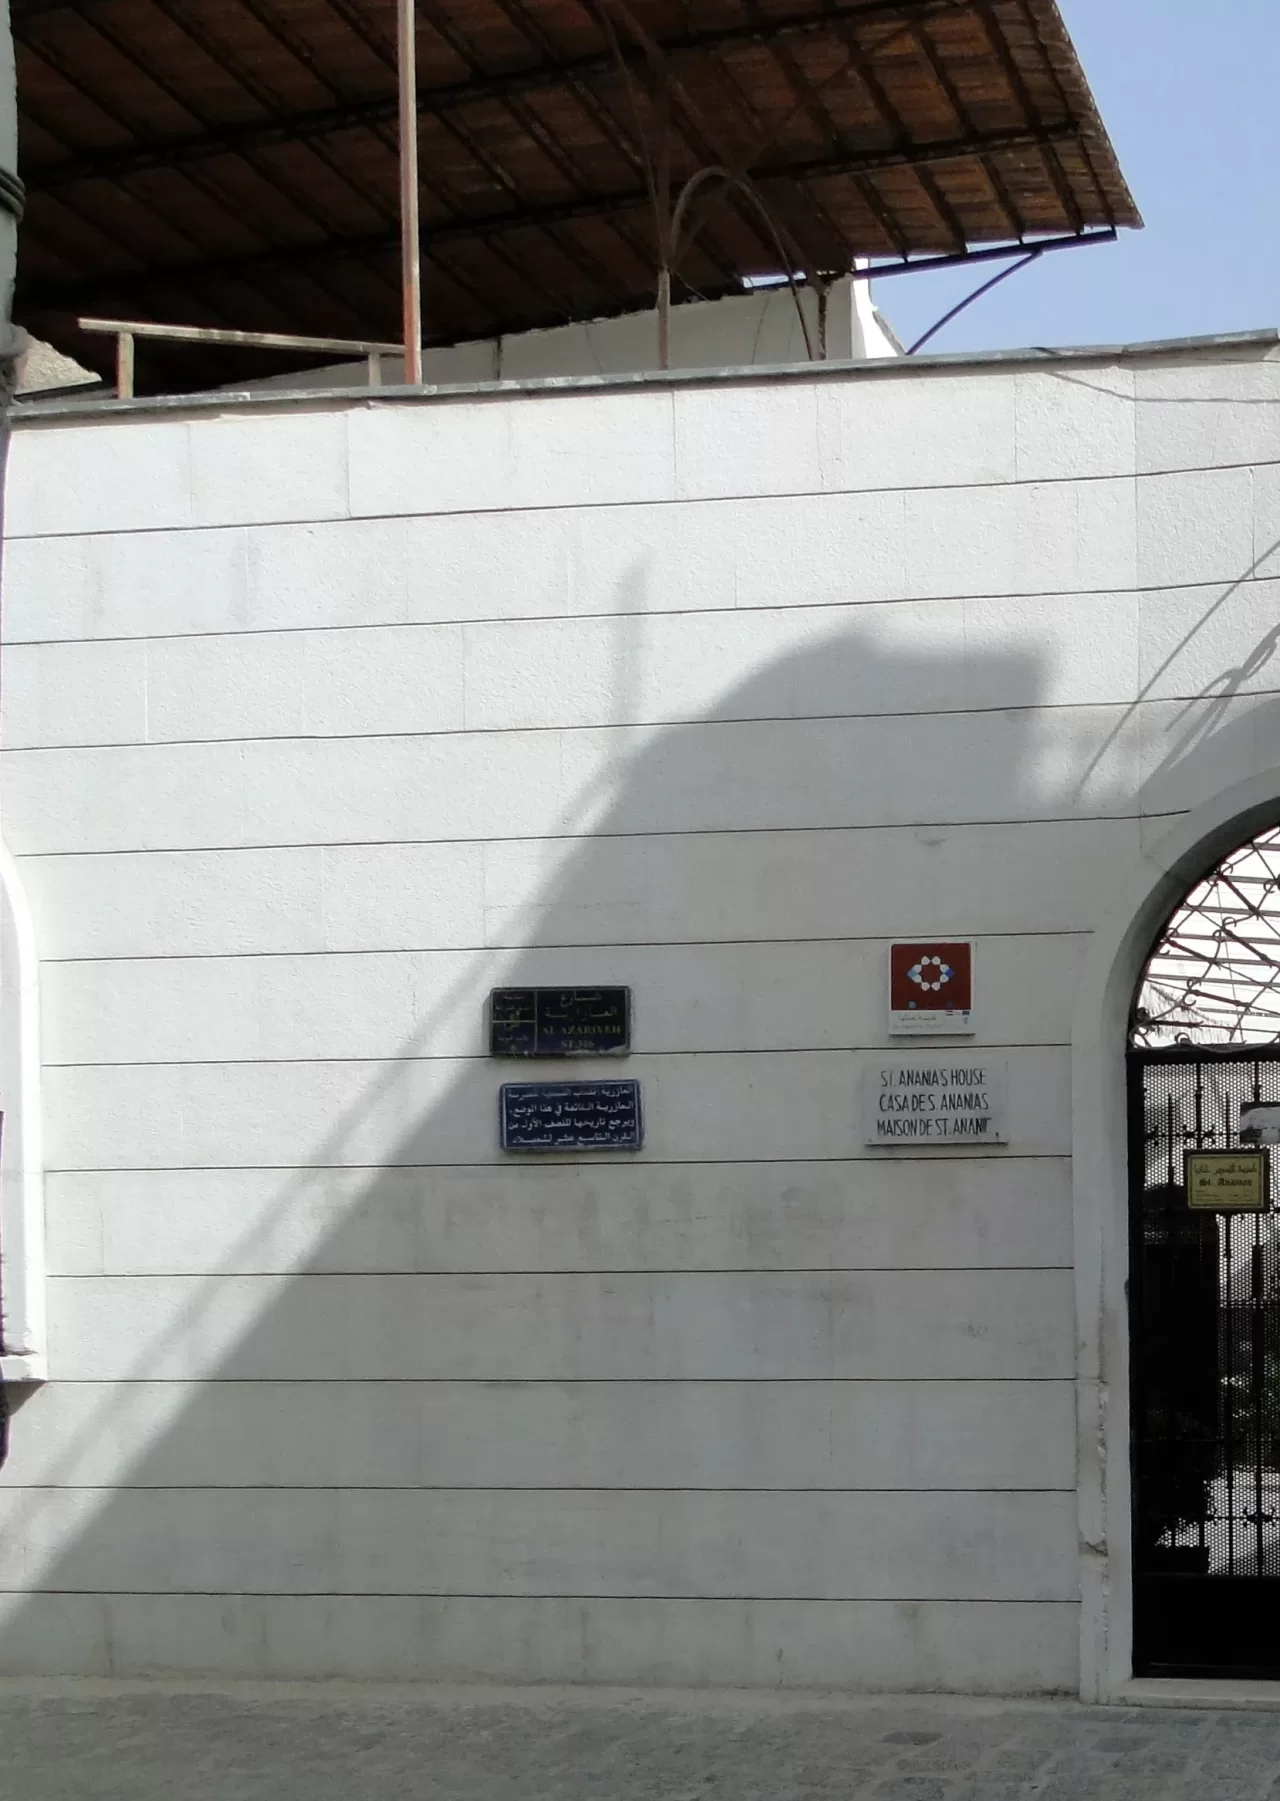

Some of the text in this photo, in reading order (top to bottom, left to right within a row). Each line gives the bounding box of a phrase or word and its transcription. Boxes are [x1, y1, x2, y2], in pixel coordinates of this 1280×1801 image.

[951, 1068, 987, 1086] HOUSE
[879, 1093, 909, 1112] CASA
[911, 1094, 926, 1112] DE
[940, 1092, 989, 1111] ANANIAS
[876, 1118, 918, 1136] MAISON
[920, 1118, 932, 1136] DE
